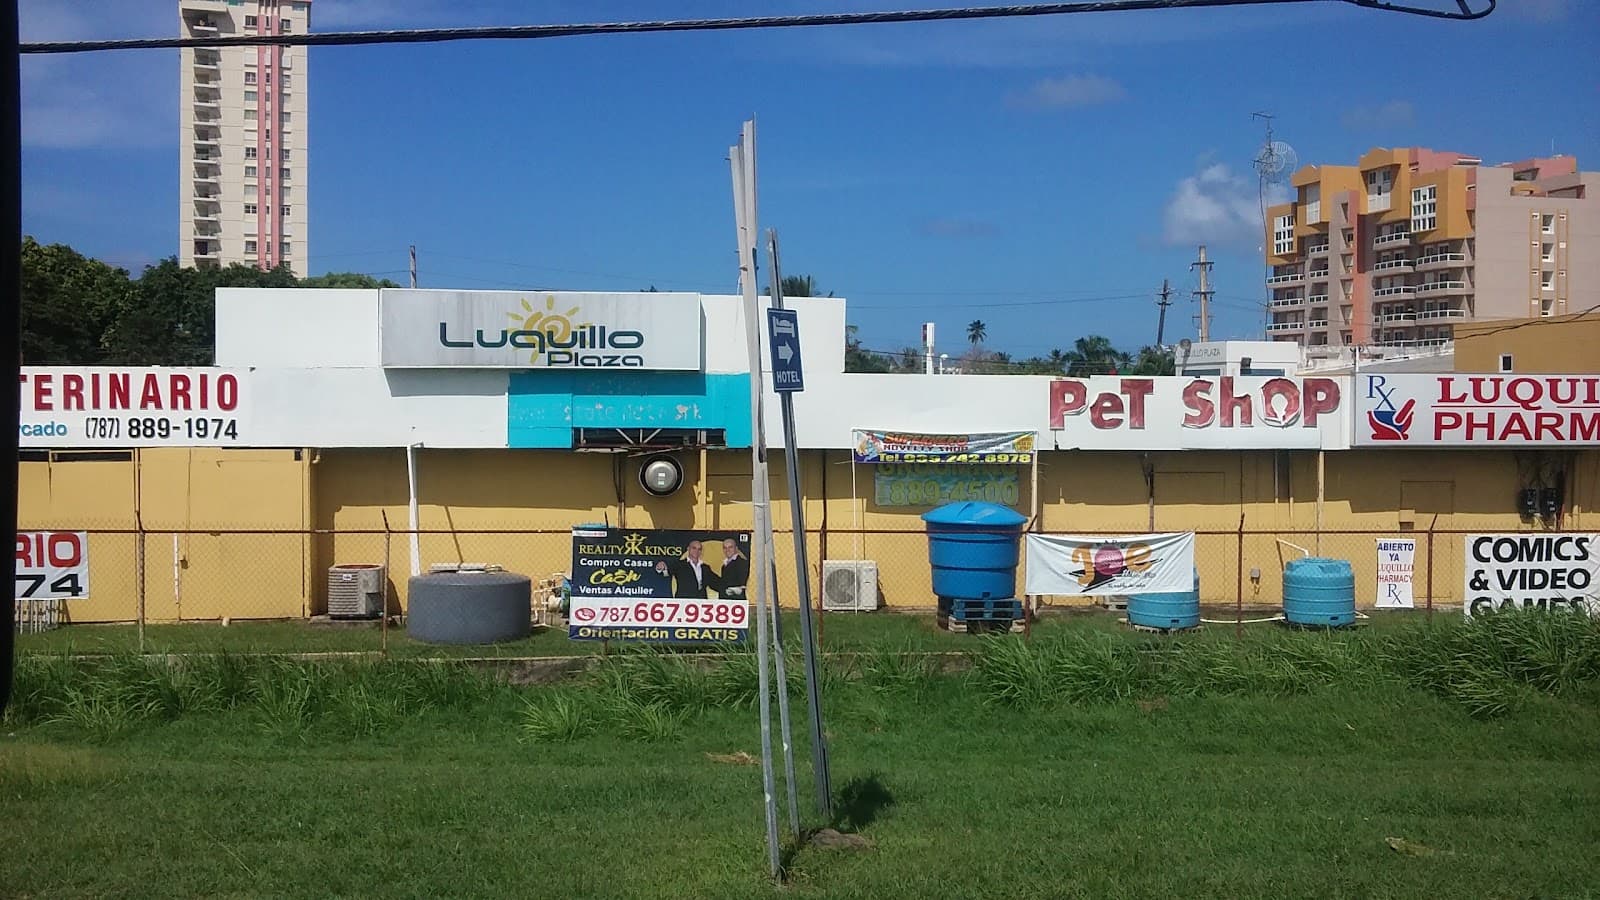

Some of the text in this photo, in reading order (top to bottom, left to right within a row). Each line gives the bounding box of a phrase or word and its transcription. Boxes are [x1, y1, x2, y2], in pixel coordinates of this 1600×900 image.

[440, 322, 644, 353] Luquillo
[546, 351, 645, 367] Plaza
[776, 370, 801, 383] HOTEL
[1436, 377, 1600, 411] LUQUI
[85, 417, 120, 439] (787)
[128, 418, 238, 440] 889-1974
[579, 545, 624, 554] REALTY
[645, 546, 682, 556] KINGS
[1377, 542, 1414, 551] ABIERTO
[1472, 536, 1589, 563] COMICS
[580, 558, 653, 567] Compro Casas
[1389, 553, 1399, 561] YA
[1378, 575, 1413, 583] HARMACY
[1469, 567, 1591, 591] & VIDEO
[579, 586, 654, 596] Ventas Alquiler
[578, 627, 738, 640] Orientación GRATIS
